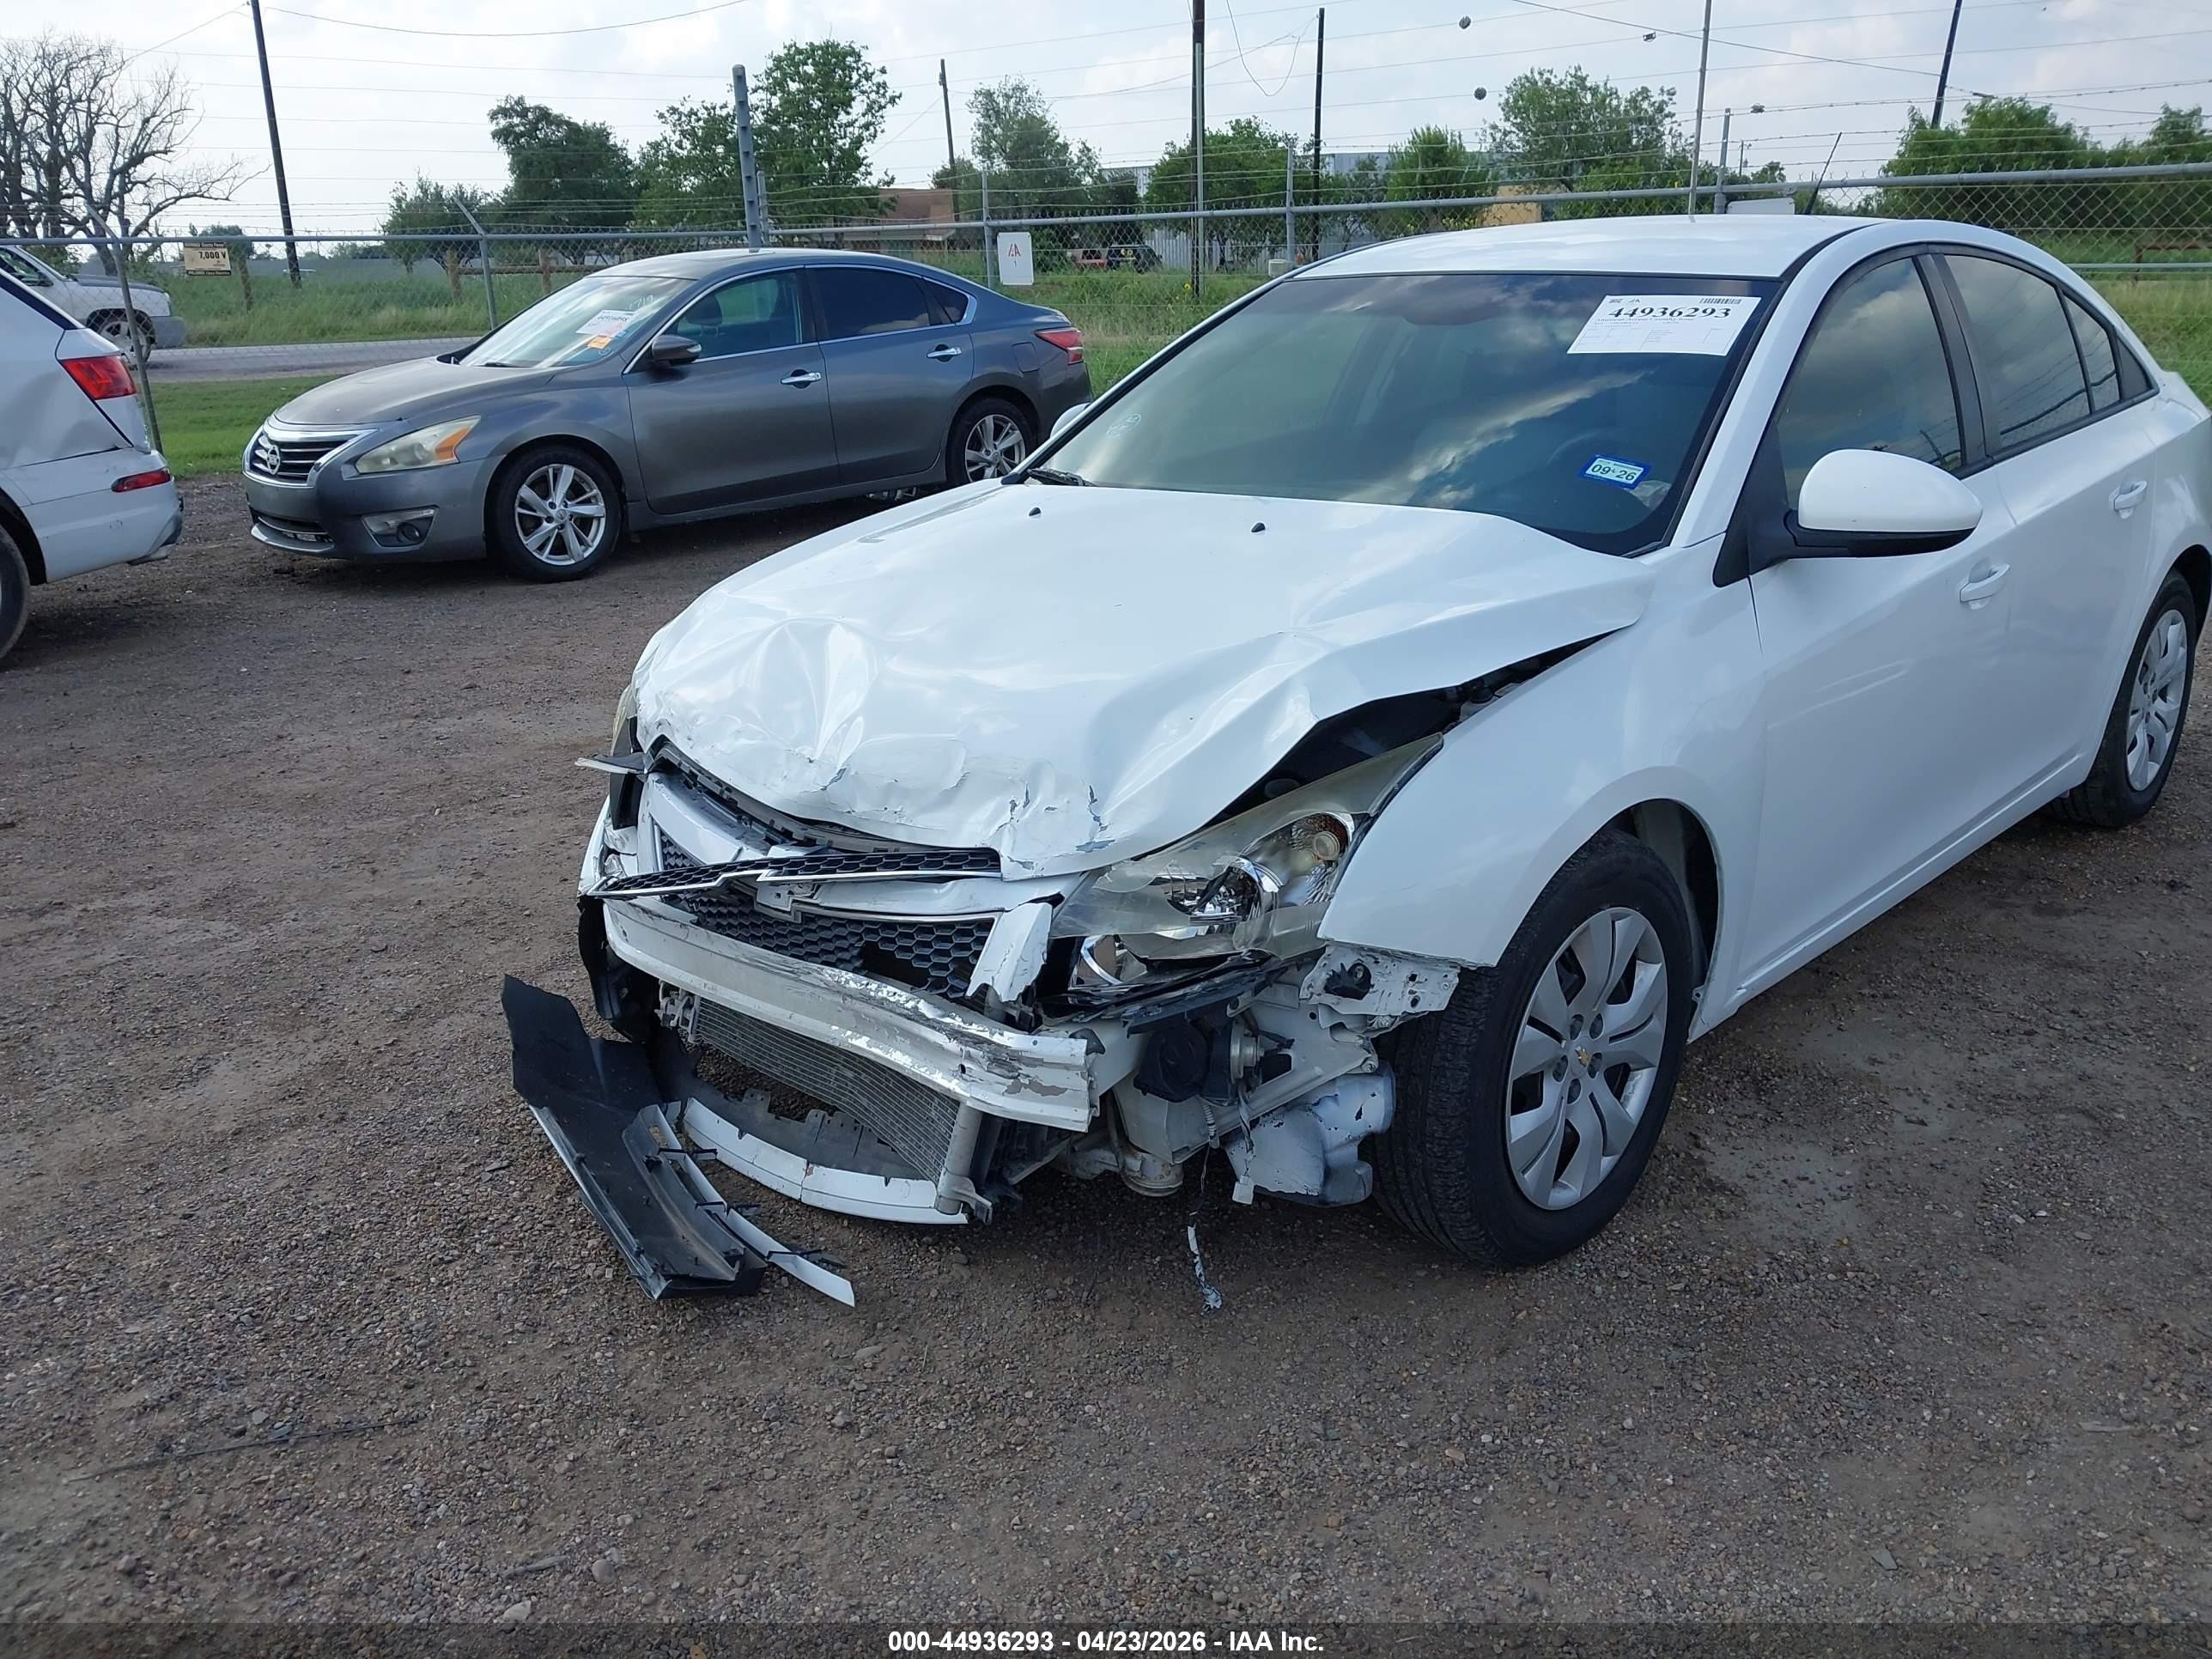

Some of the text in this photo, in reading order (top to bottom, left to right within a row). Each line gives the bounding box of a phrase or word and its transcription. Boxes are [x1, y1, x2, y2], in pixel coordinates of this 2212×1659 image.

[1607, 307, 1732, 319] 44936293
[1591, 464, 1637, 481] 09 26
